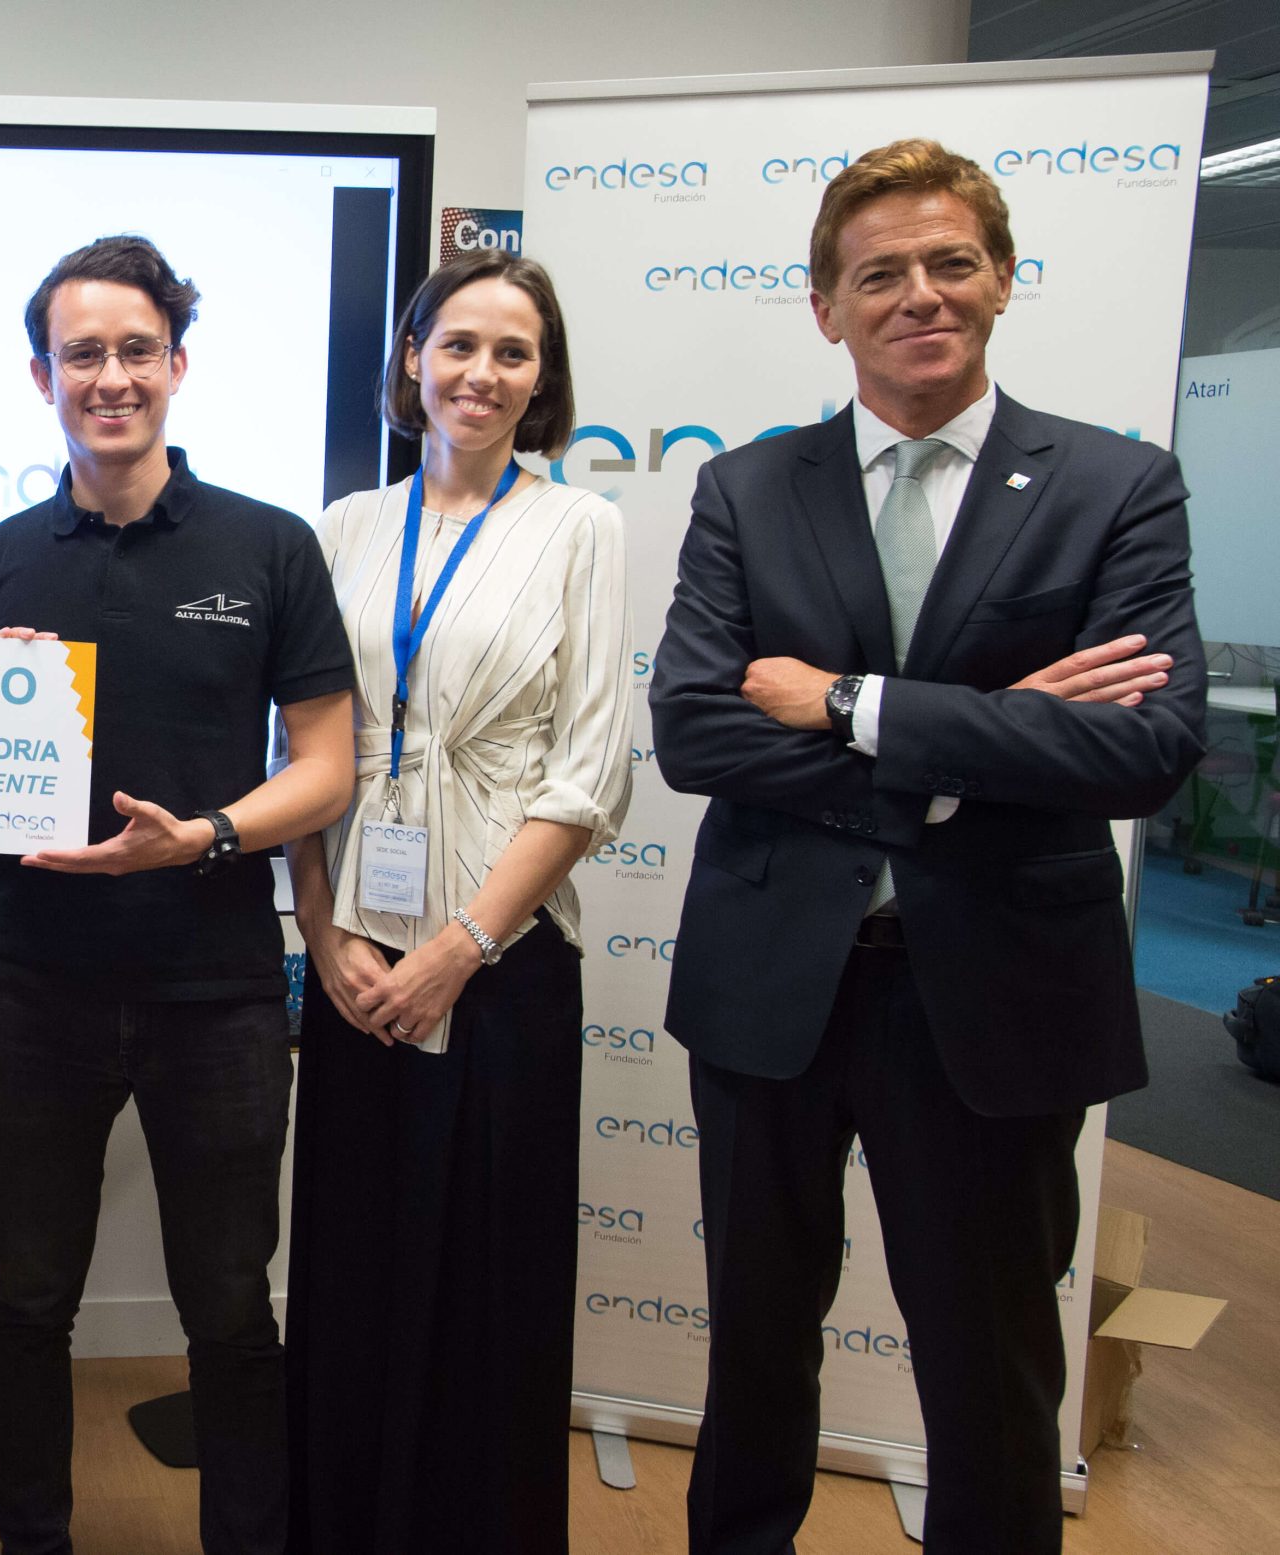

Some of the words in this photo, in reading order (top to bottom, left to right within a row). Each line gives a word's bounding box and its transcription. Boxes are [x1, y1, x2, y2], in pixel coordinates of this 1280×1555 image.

[994, 140, 1180, 176] endesa
[545, 157, 708, 191] endesa
[1117, 178, 1177, 188] Fundación
[654, 193, 706, 203] Fundación
[645, 259, 809, 291] endesa
[755, 296, 808, 305] Fundación
[1186, 379, 1230, 399] Atari
[175, 611, 202, 620] ALTA
[363, 825, 426, 843] endesa
[577, 842, 666, 867] esa
[615, 869, 664, 880] Fundación
[604, 1052, 653, 1066] Fundación
[594, 1231, 642, 1245] Fundación
